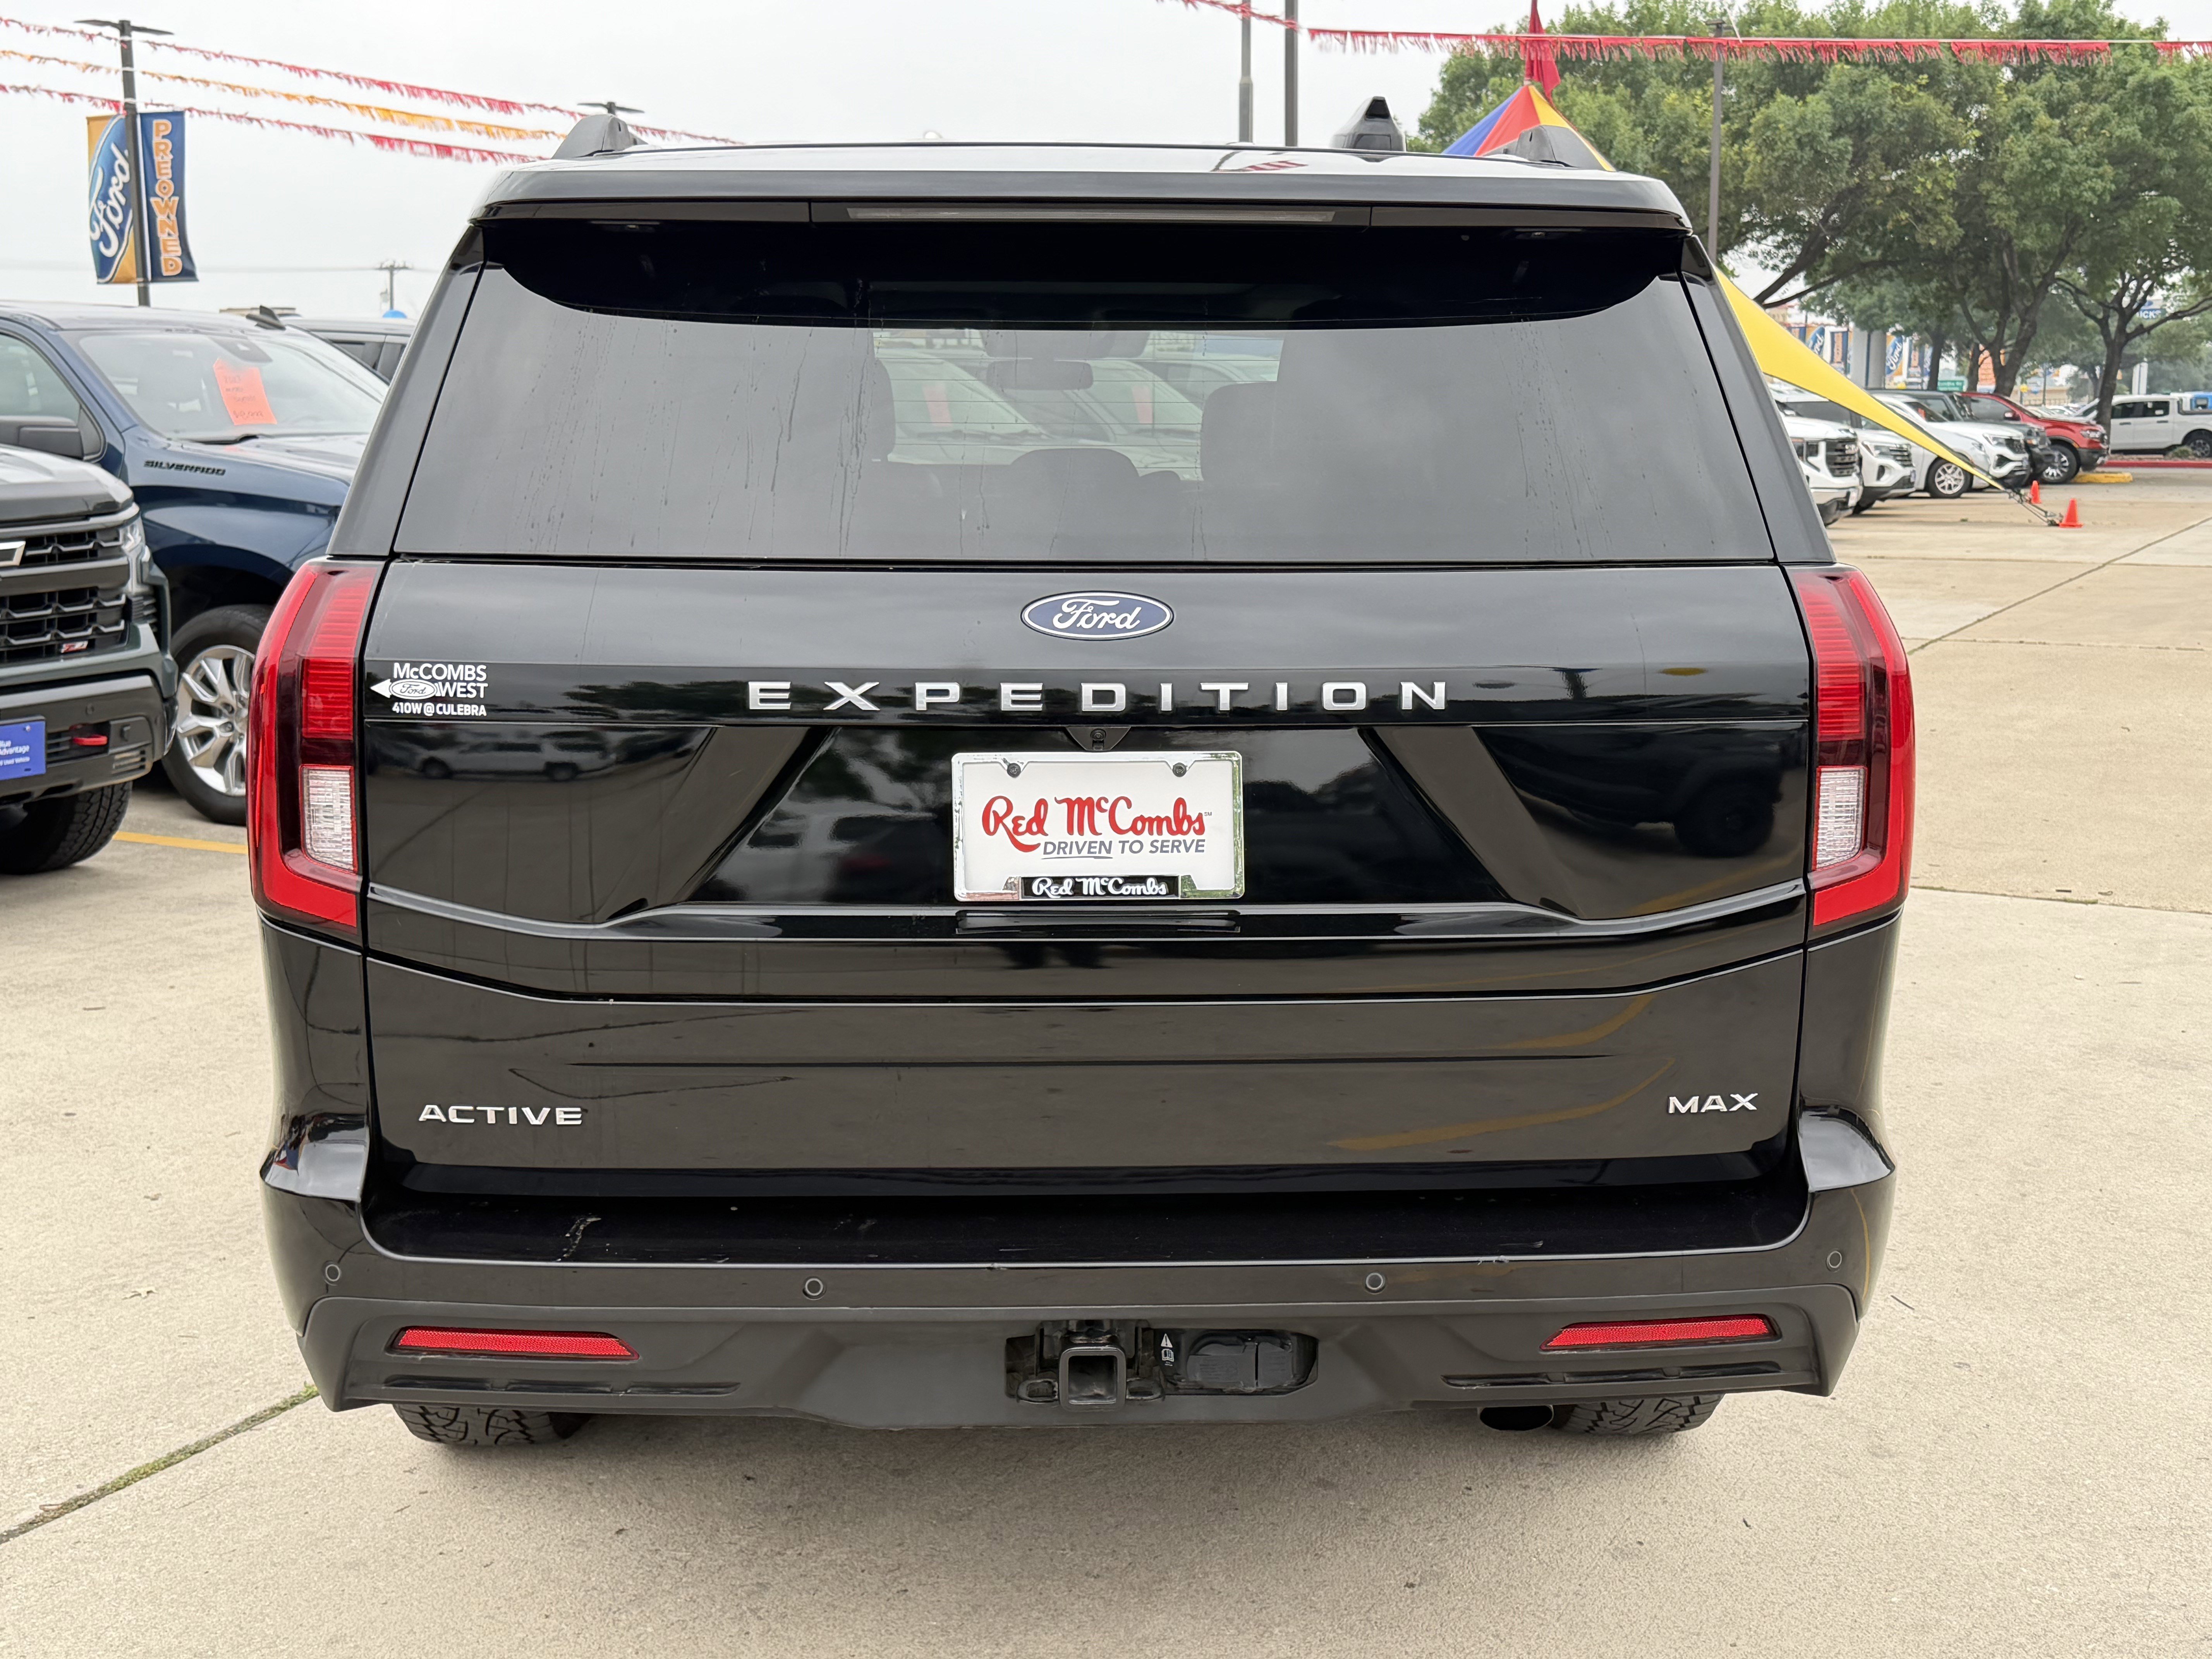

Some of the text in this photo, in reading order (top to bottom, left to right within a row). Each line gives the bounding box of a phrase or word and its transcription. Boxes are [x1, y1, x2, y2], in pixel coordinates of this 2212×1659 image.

[89, 142, 131, 258] Ford
[150, 119, 182, 276] PREOWNED
[144, 460, 227, 476] SILVERADO
[1052, 598, 1142, 629] Ford
[393, 662, 488, 682] McCOMBS
[400, 682, 489, 699] Ford WEST
[748, 681, 1446, 711] EXPEDITION
[436, 703, 487, 716] CULEBRA
[981, 795, 1049, 853] Red
[1054, 795, 1206, 836] McCombs
[1042, 838, 1206, 855] DRIVEN TO SERVE
[1032, 877, 1168, 898] Red McCombs
[1668, 1092, 1759, 1114] MAX
[418, 1104, 582, 1125] ACTIVE
